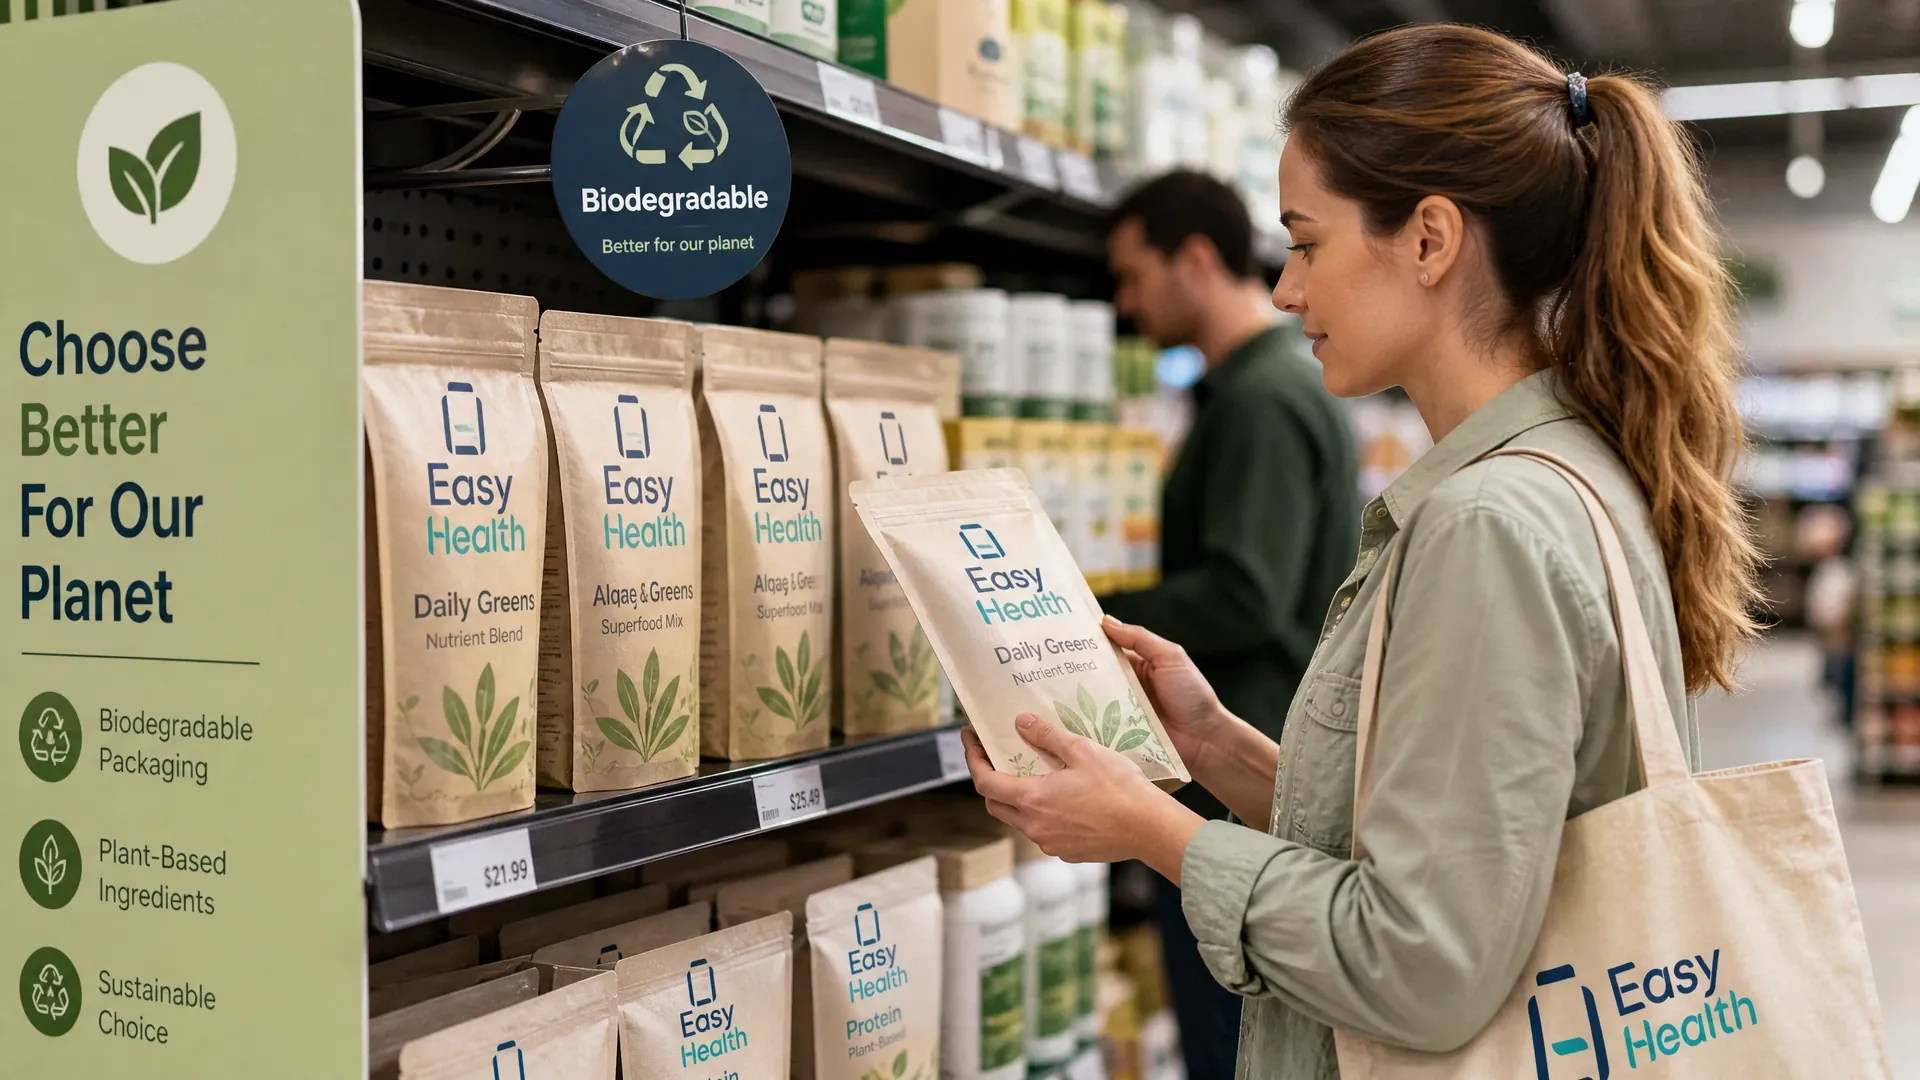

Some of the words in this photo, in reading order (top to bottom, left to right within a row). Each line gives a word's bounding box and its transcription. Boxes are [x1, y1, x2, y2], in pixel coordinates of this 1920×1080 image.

[581, 185, 769, 217] Biodegradable
[602, 238, 650, 254] Better
[654, 237, 675, 252] for
[679, 238, 704, 251] our
[708, 235, 754, 254] planet
[19, 320, 207, 377] Choose
[21, 402, 167, 456] Better
[427, 462, 513, 514] Easy
[603, 465, 673, 513] Easy
[753, 468, 809, 510] Easy
[21, 483, 94, 538] For
[110, 481, 203, 538] Our
[754, 511, 822, 544] Health
[427, 514, 525, 555] Health
[604, 512, 685, 550] Health
[21, 565, 173, 623] Planet
[640, 583, 648, 603] &
[649, 581, 694, 602] Greens
[965, 566, 1043, 593] Easy
[413, 592, 471, 622] Daily
[477, 590, 535, 613] Greens
[757, 602, 807, 621] Superfood
[975, 591, 1073, 625] Health
[425, 629, 485, 650] Nutrient
[489, 625, 523, 643] Blend
[601, 616, 663, 637] Superfood
[665, 613, 684, 628] Mix
[994, 641, 1043, 665] Daily
[1044, 637, 1098, 655] Greens
[1012, 667, 1065, 686] Nutrient
[1065, 658, 1098, 674] Blend
[99, 707, 254, 743] Biodegradable
[99, 747, 209, 786] Packaging
[789, 787, 820, 812] $25.49
[99, 838, 227, 876] Plant-Based
[484, 858, 528, 889] $21.99
[99, 877, 215, 915] Ingredients
[848, 944, 897, 975] Easy
[98, 970, 217, 1011] Sustainable
[848, 965, 908, 1004] Health
[1607, 948, 1720, 1017] Easy
[98, 1010, 169, 1044] Choice
[679, 1004, 735, 1039] Easy
[846, 1005, 903, 1041] Protein
[1623, 989, 1758, 1069] Health
[680, 1027, 748, 1068] Health
